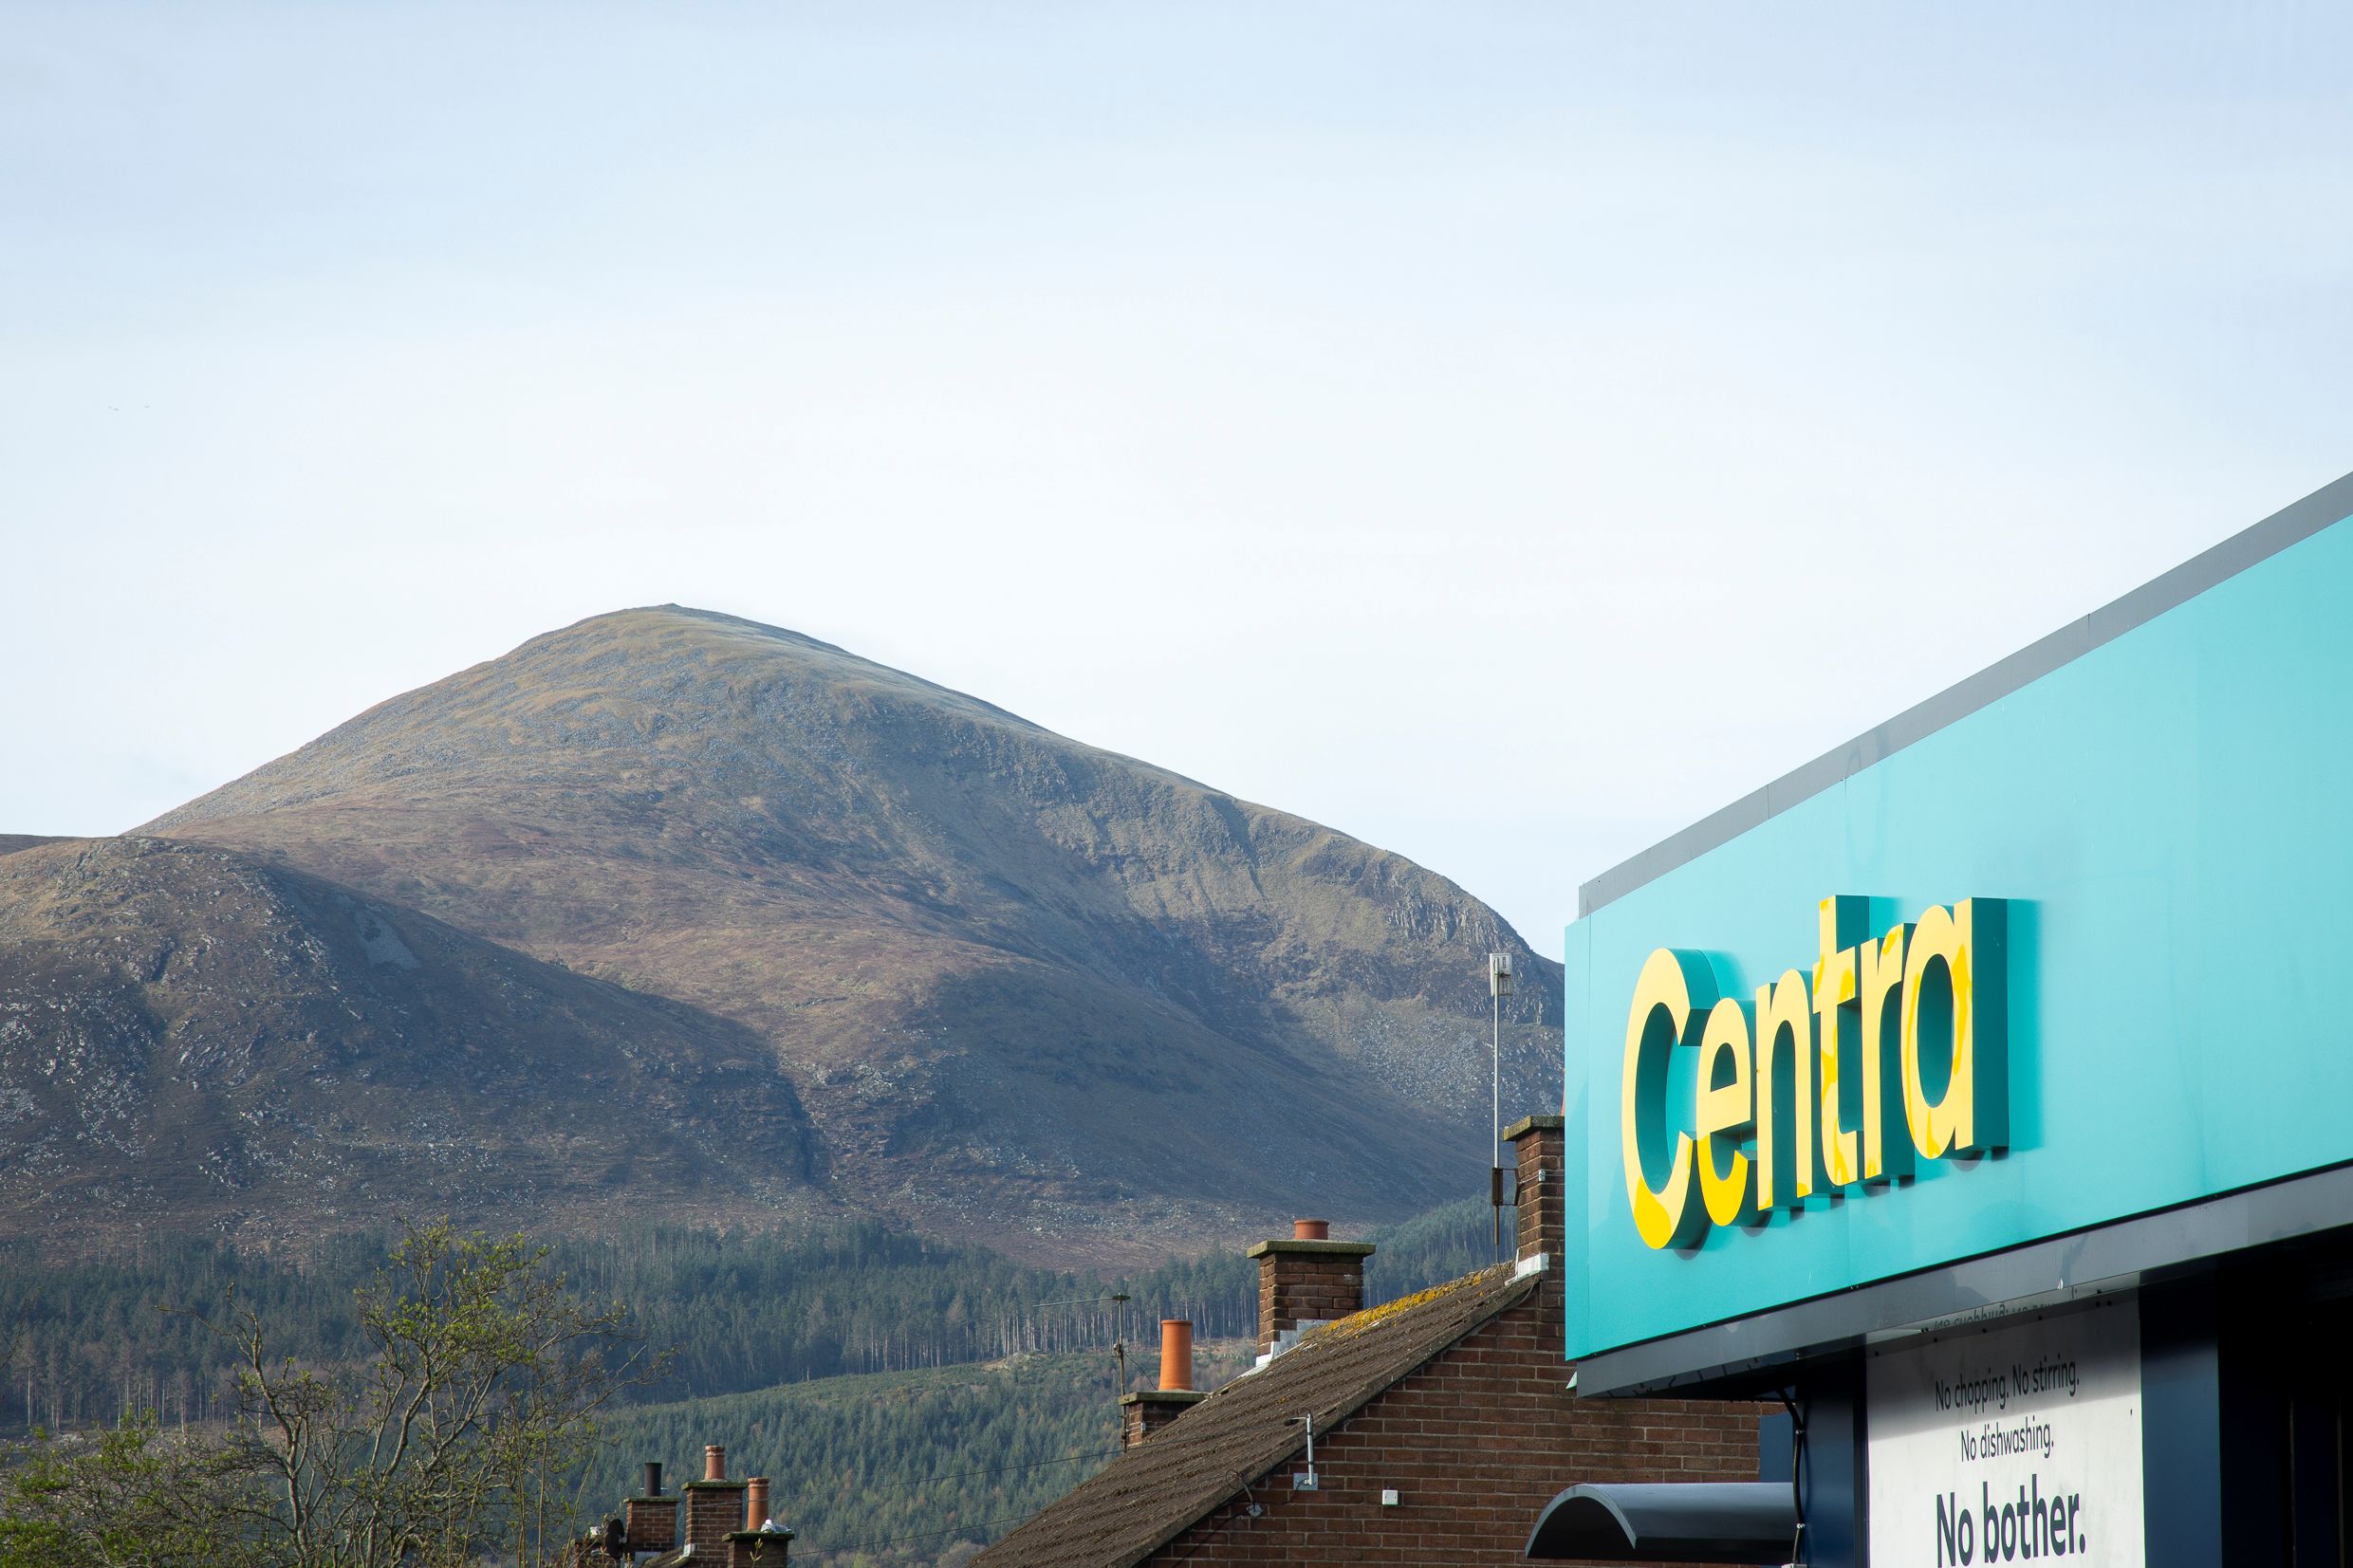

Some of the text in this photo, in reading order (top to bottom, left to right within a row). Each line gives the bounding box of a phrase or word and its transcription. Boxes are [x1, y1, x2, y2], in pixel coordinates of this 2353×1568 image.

[1621, 895, 1992, 1249] Centra
[1936, 1353, 2080, 1413] No chopping. No stirring.
[1961, 1415, 2054, 1462] No dishwashing.
[1936, 1474, 2085, 1568] No bother.
